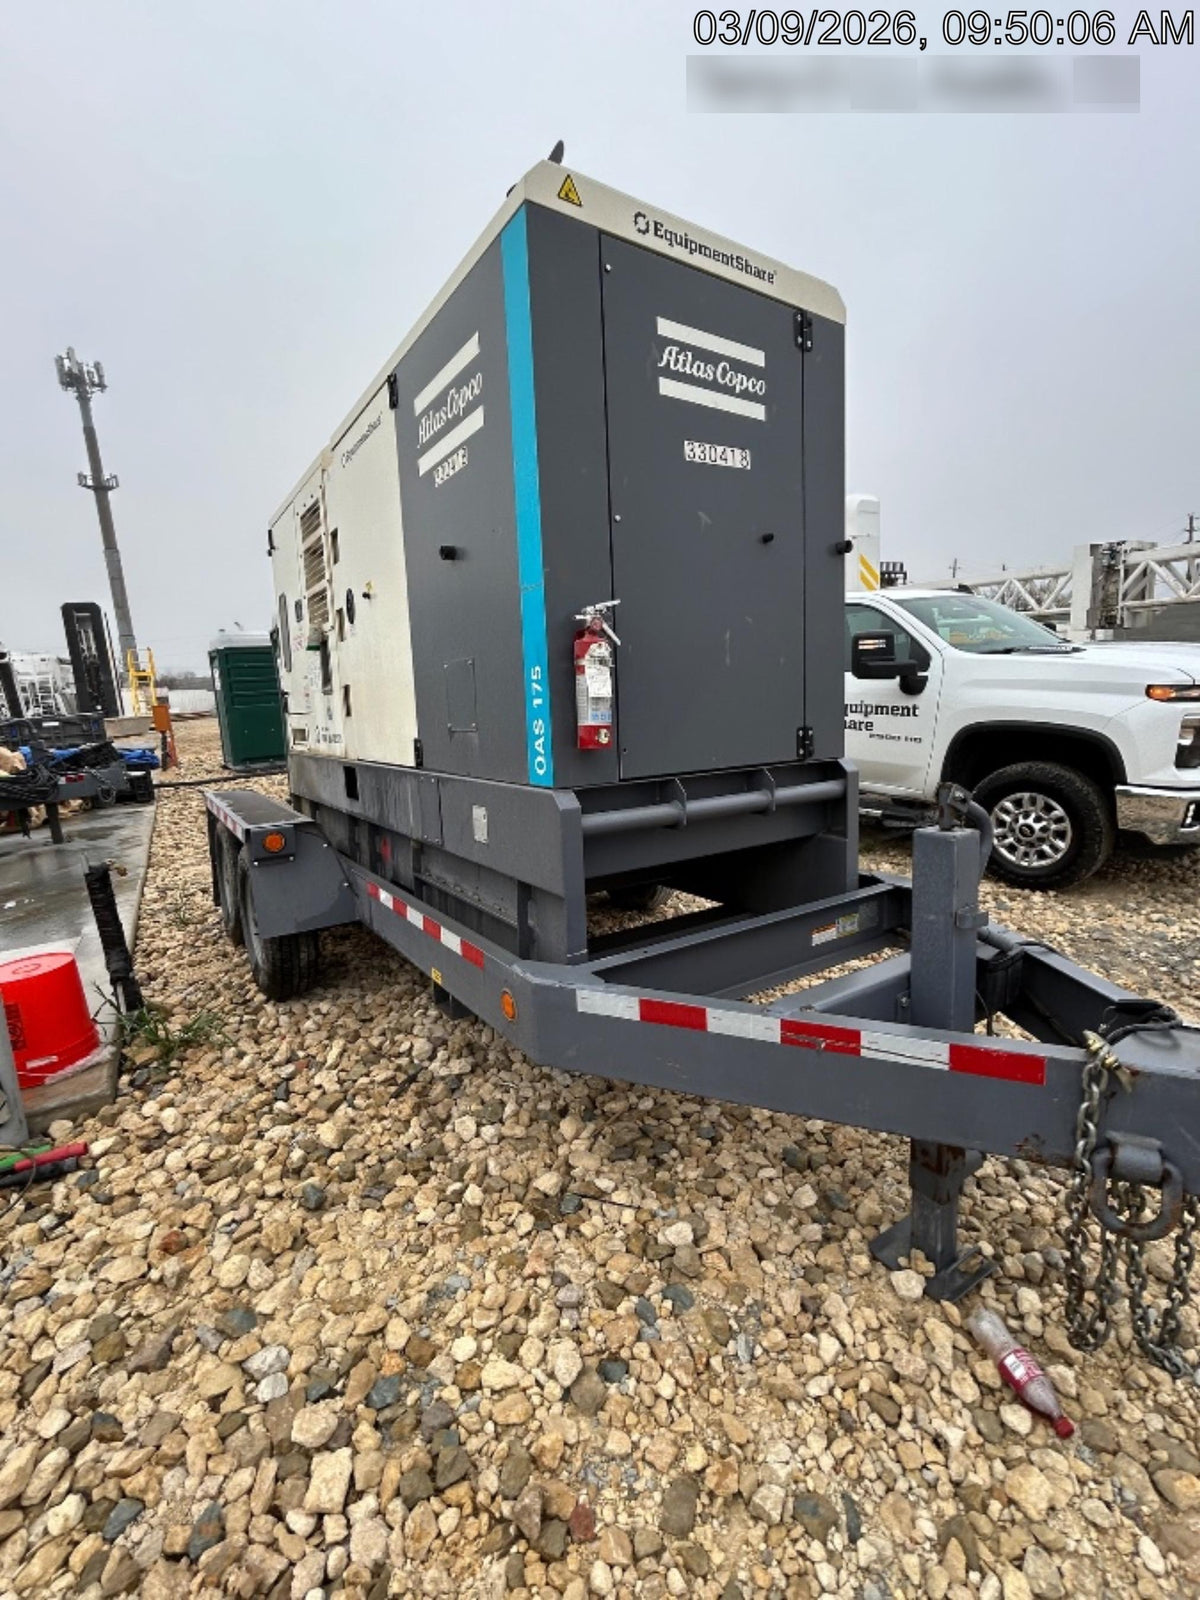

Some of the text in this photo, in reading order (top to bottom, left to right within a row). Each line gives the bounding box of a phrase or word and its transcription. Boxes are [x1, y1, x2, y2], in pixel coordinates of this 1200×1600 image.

[653, 220, 774, 284] EquipmentShare
[657, 345, 766, 395] Atlas Copco
[417, 406, 447, 449] Atlas
[686, 441, 749, 469] 330418
[530, 664, 544, 709] 175
